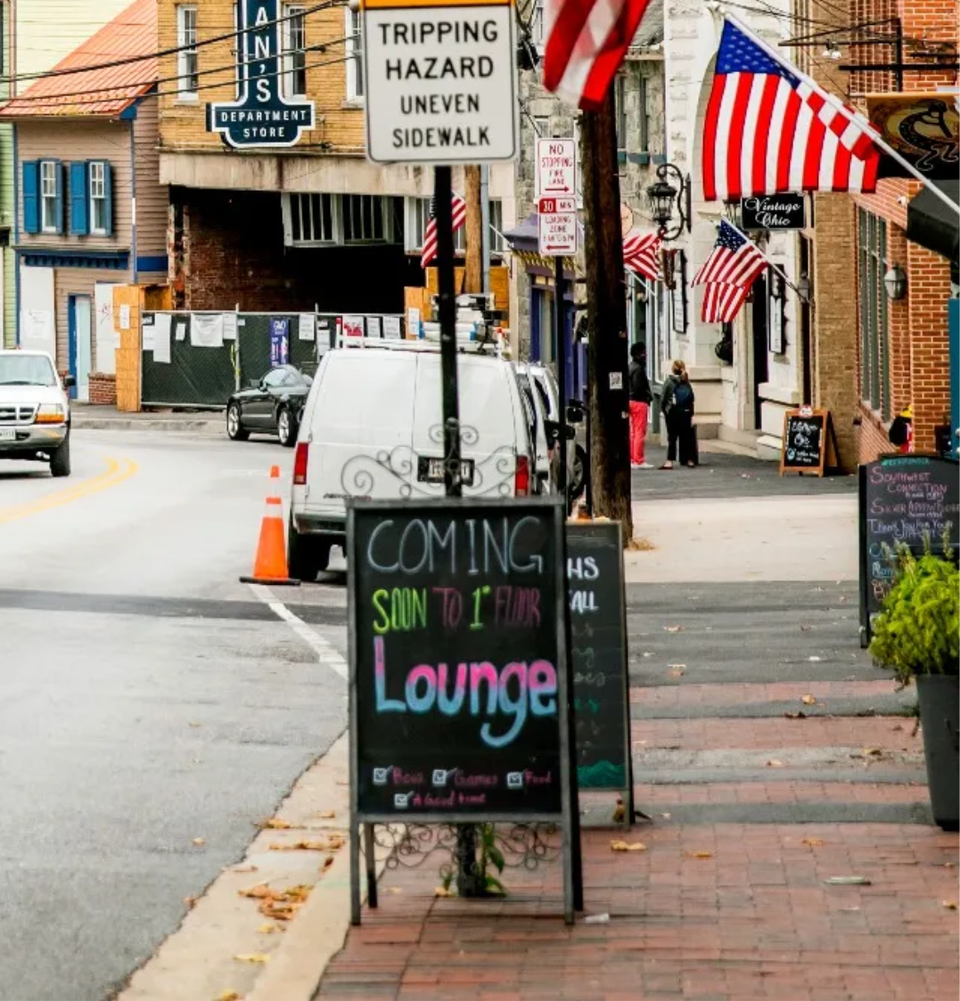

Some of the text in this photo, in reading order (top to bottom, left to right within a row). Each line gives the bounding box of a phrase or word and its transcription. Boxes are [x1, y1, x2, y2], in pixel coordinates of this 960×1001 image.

[378, 20, 498, 45] TRIPPING
[385, 56, 494, 80] HAZARD
[400, 93, 480, 114] UNEVEN
[221, 110, 307, 122] DEPARTMENT
[243, 127, 285, 138] STORE
[392, 126, 491, 148] SIDEWALK
[549, 144, 564, 155] NO
[542, 157, 572, 168] STOPPING
[744, 197, 801, 214] Vintage
[544, 215, 572, 224] LOADING
[549, 224, 567, 233] ZONE
[755, 210, 791, 229] Chic
[367, 516, 543, 574] COMING
[372, 587, 427, 635] SOON
[432, 586, 463, 627] TO
[494, 585, 541, 627] FLOOR
[373, 635, 558, 748] Lounge
[525, 768, 552, 785] Food
